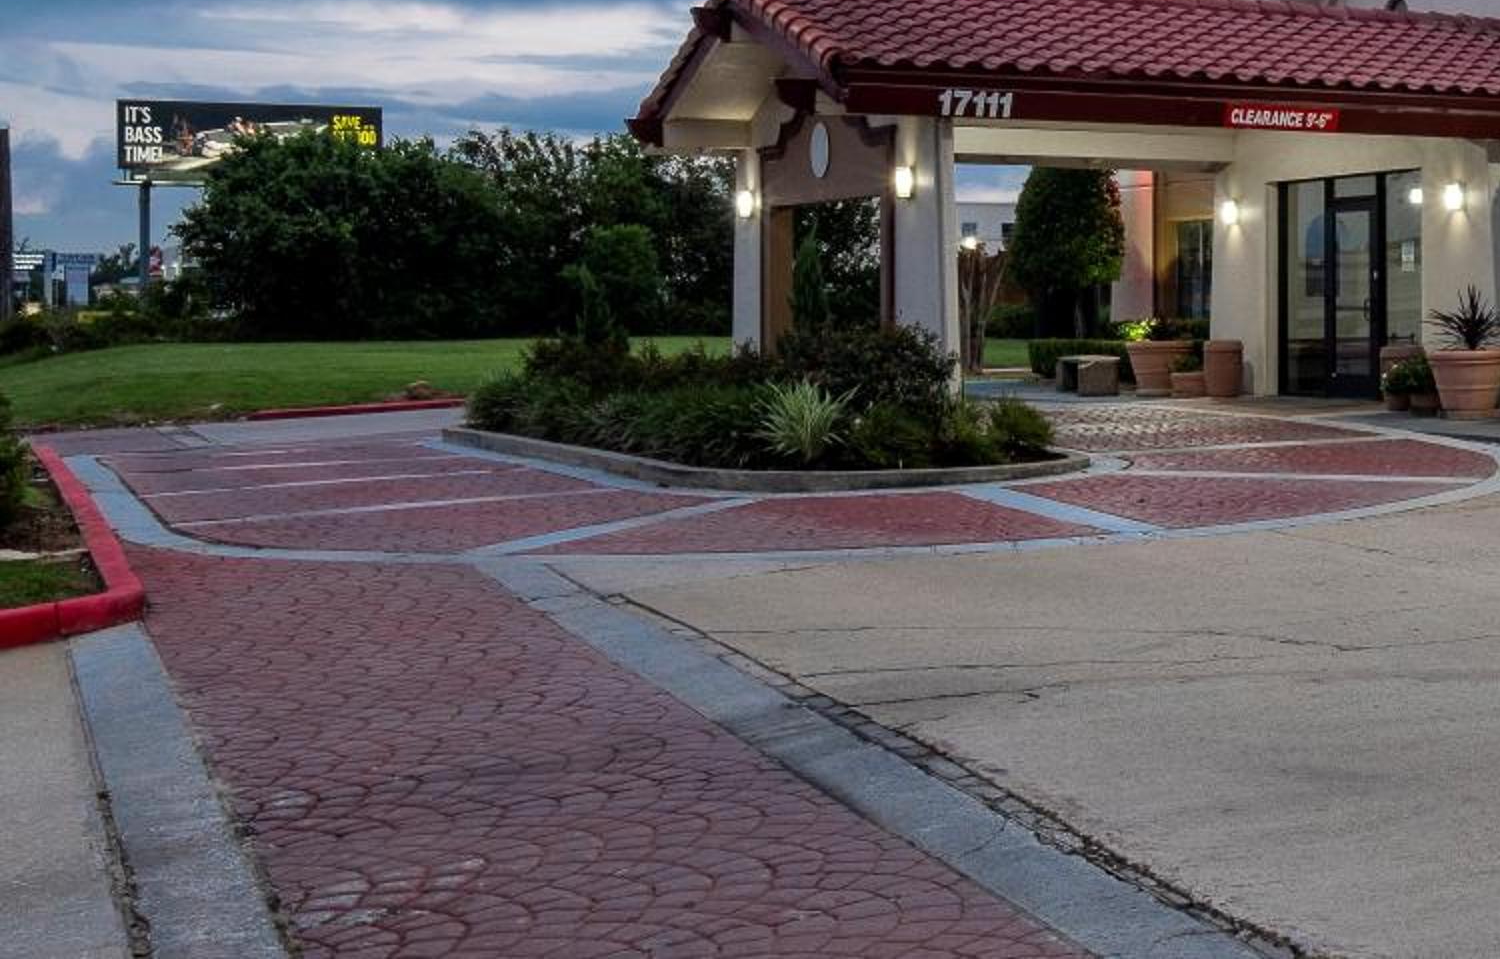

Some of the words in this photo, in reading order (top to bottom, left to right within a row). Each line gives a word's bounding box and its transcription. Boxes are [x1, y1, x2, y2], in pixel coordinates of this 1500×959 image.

[938, 88, 1013, 118] 17111
[125, 106, 151, 123] IT'S
[1231, 108, 1305, 128] CLEARANCE
[125, 126, 162, 143] BASS
[124, 146, 162, 162] TIME!
